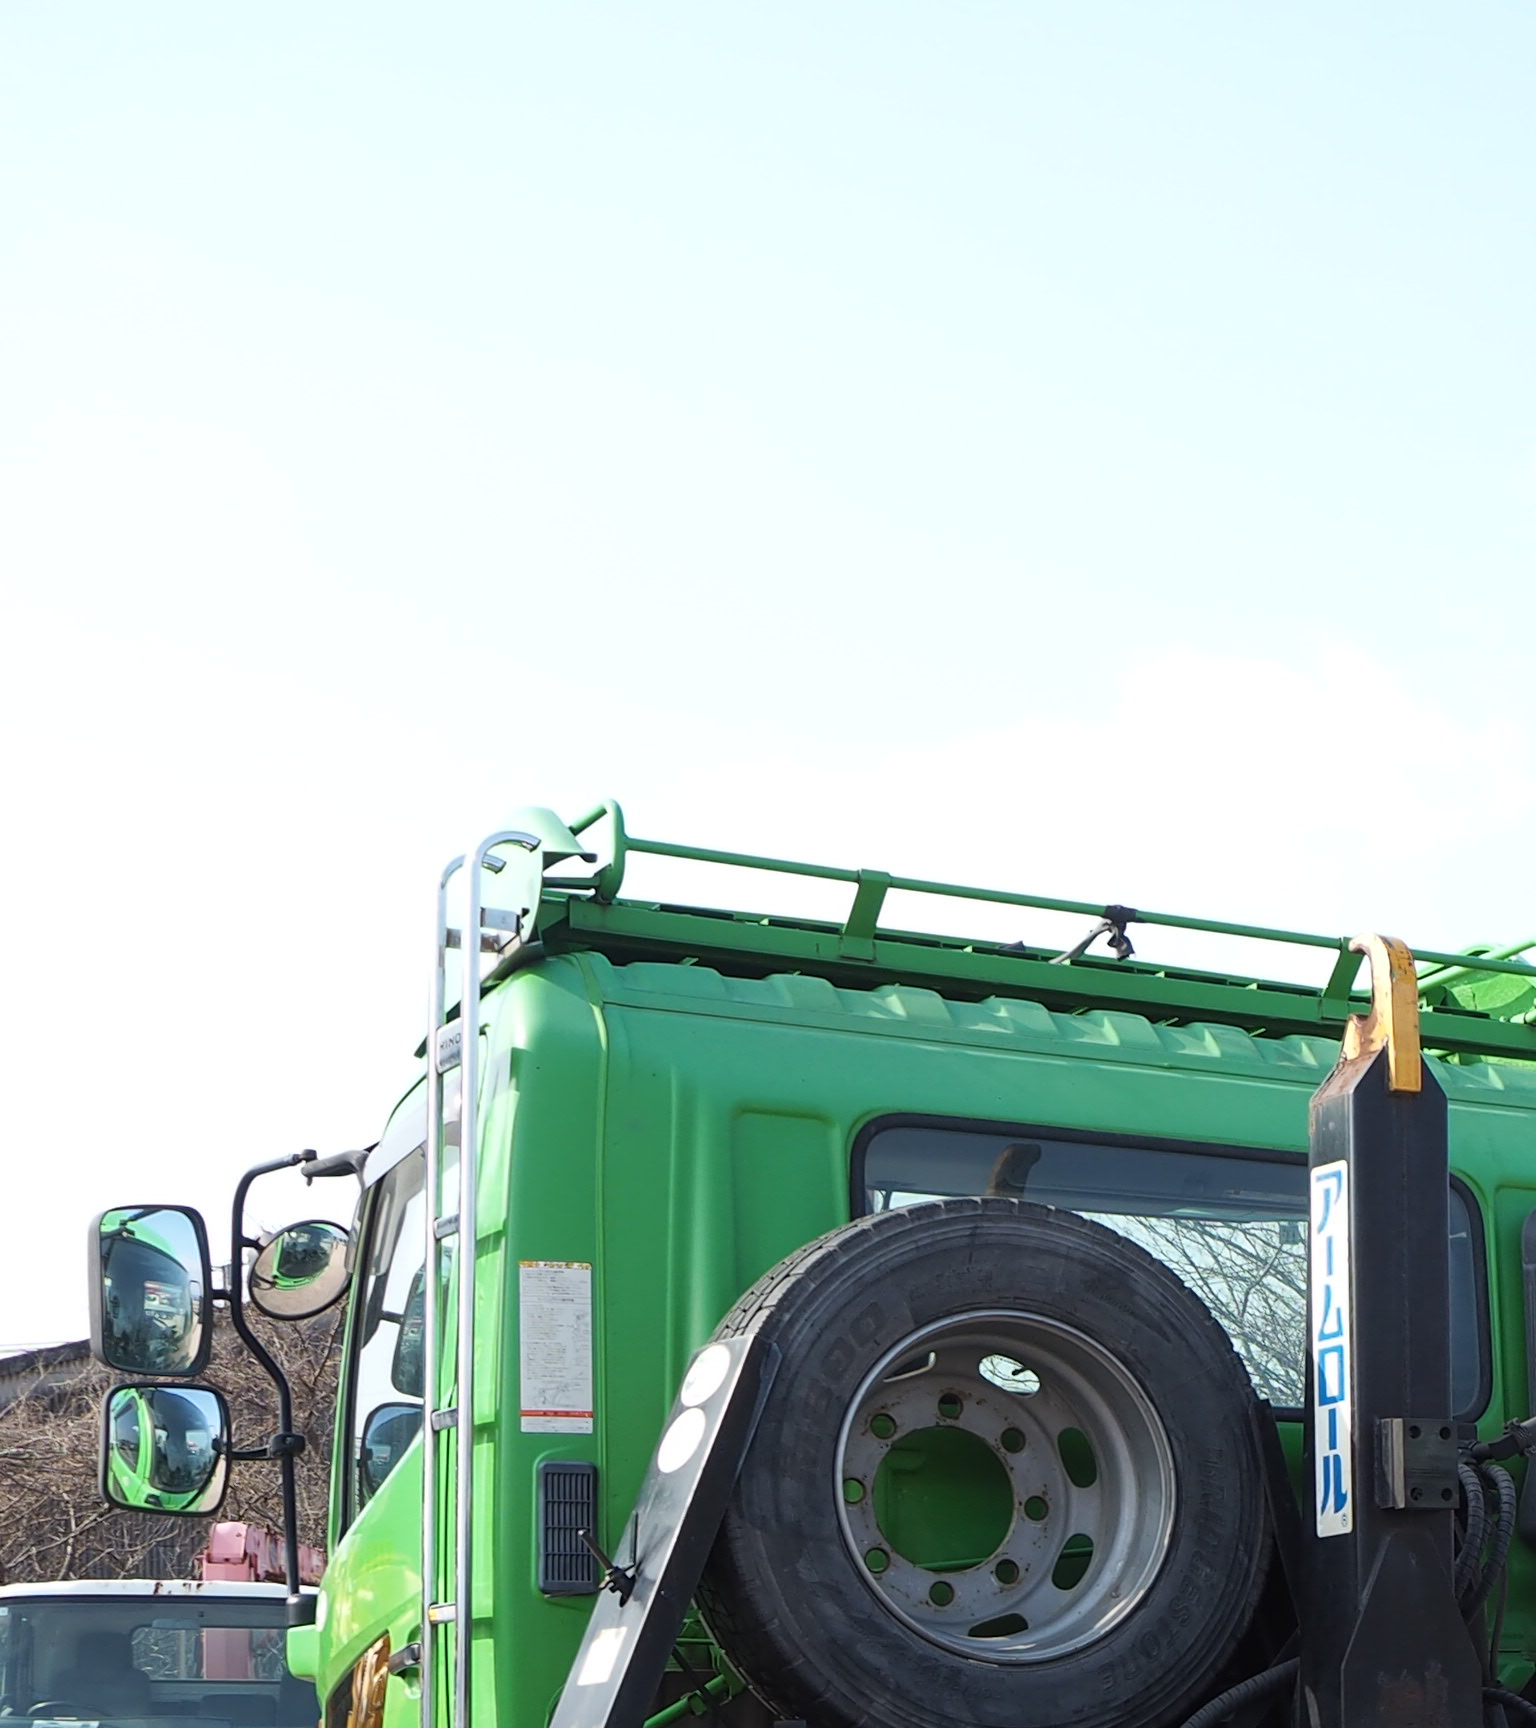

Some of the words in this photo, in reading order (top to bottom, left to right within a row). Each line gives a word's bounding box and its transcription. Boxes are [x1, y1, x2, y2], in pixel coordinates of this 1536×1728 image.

[1315, 1169, 1349, 1516] アームロール
